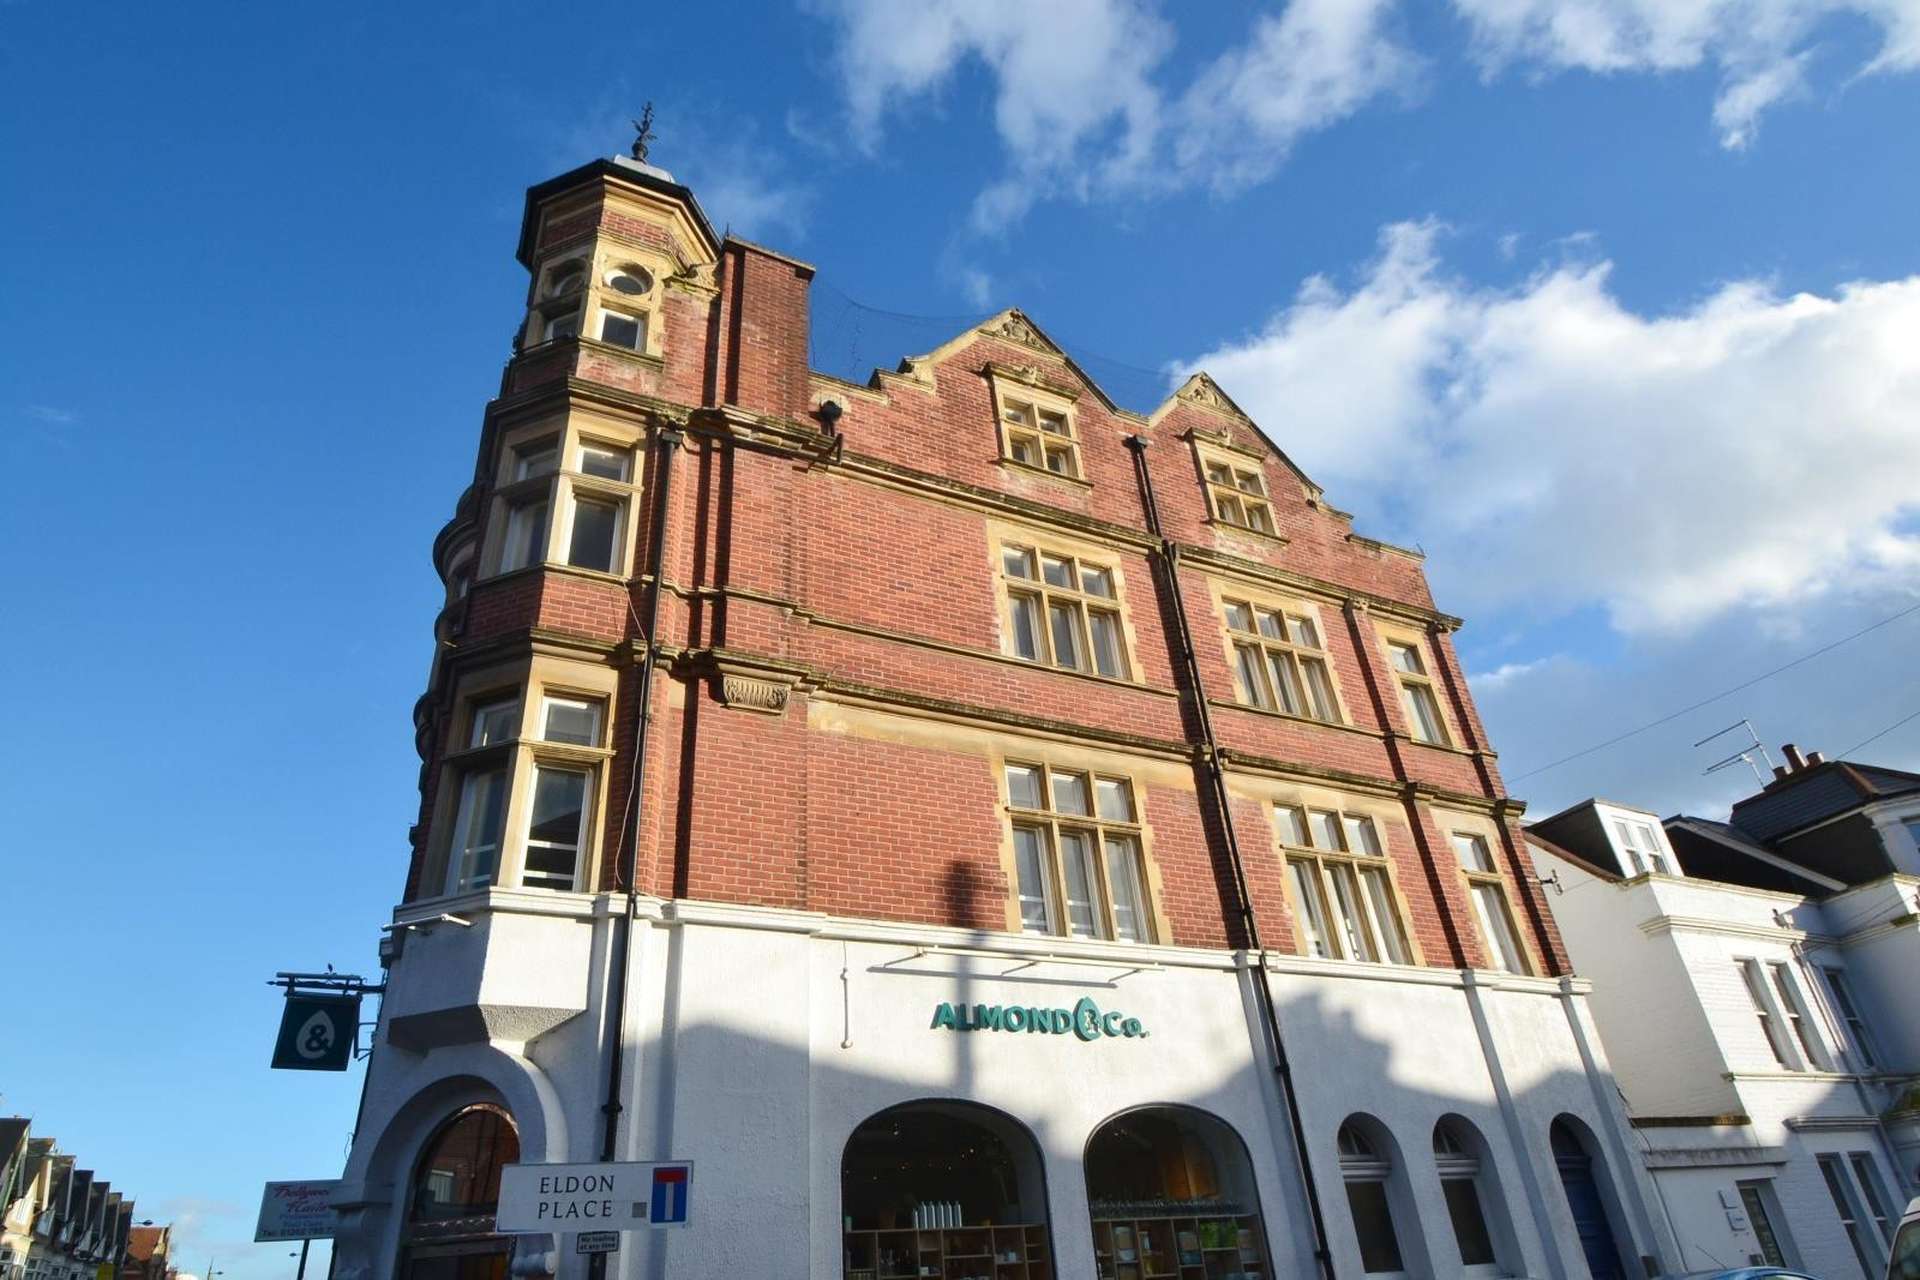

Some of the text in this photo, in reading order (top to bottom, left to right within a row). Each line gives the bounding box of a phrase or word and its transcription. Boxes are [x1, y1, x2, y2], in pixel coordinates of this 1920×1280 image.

[931, 1002, 1074, 1034] ALMOND
[539, 1175, 615, 1193] ELDON
[538, 1200, 612, 1219] PLACE
